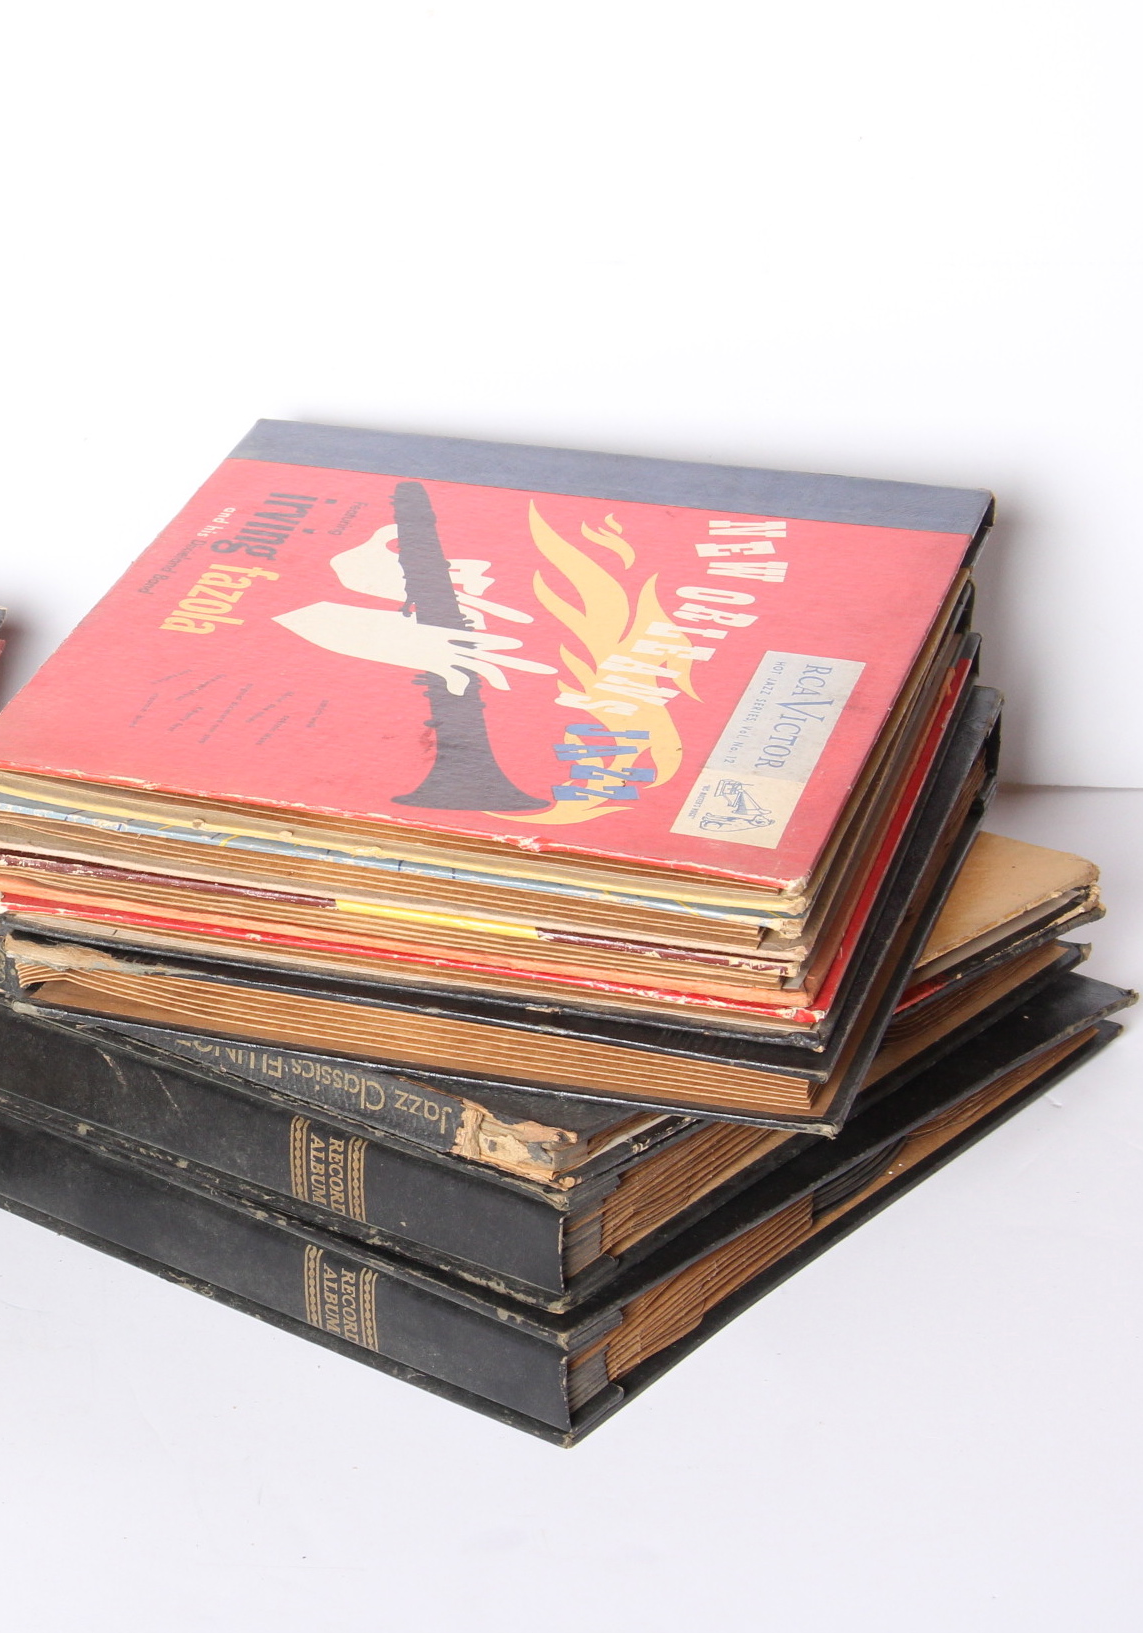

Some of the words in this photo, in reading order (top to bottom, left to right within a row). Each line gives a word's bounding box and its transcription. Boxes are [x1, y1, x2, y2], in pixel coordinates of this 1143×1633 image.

[197, 523, 218, 537] his
[210, 492, 338, 561] irving
[213, 507, 237, 525] and
[329, 502, 368, 536] Featuring
[164, 538, 207, 573] Dixieland
[694, 520, 789, 583] NEW
[158, 563, 280, 635] fazola
[554, 585, 759, 716] ORLEANS
[773, 660, 787, 675] HOT
[760, 678, 779, 697] JAZZ
[551, 723, 657, 802] JAZZ
[724, 755, 736, 764] 12
[291, 1058, 386, 1111] Classics
[394, 1089, 453, 1134] Jazz
[310, 1132, 327, 1206] ALBUM
[323, 1263, 341, 1335] ALBUM
